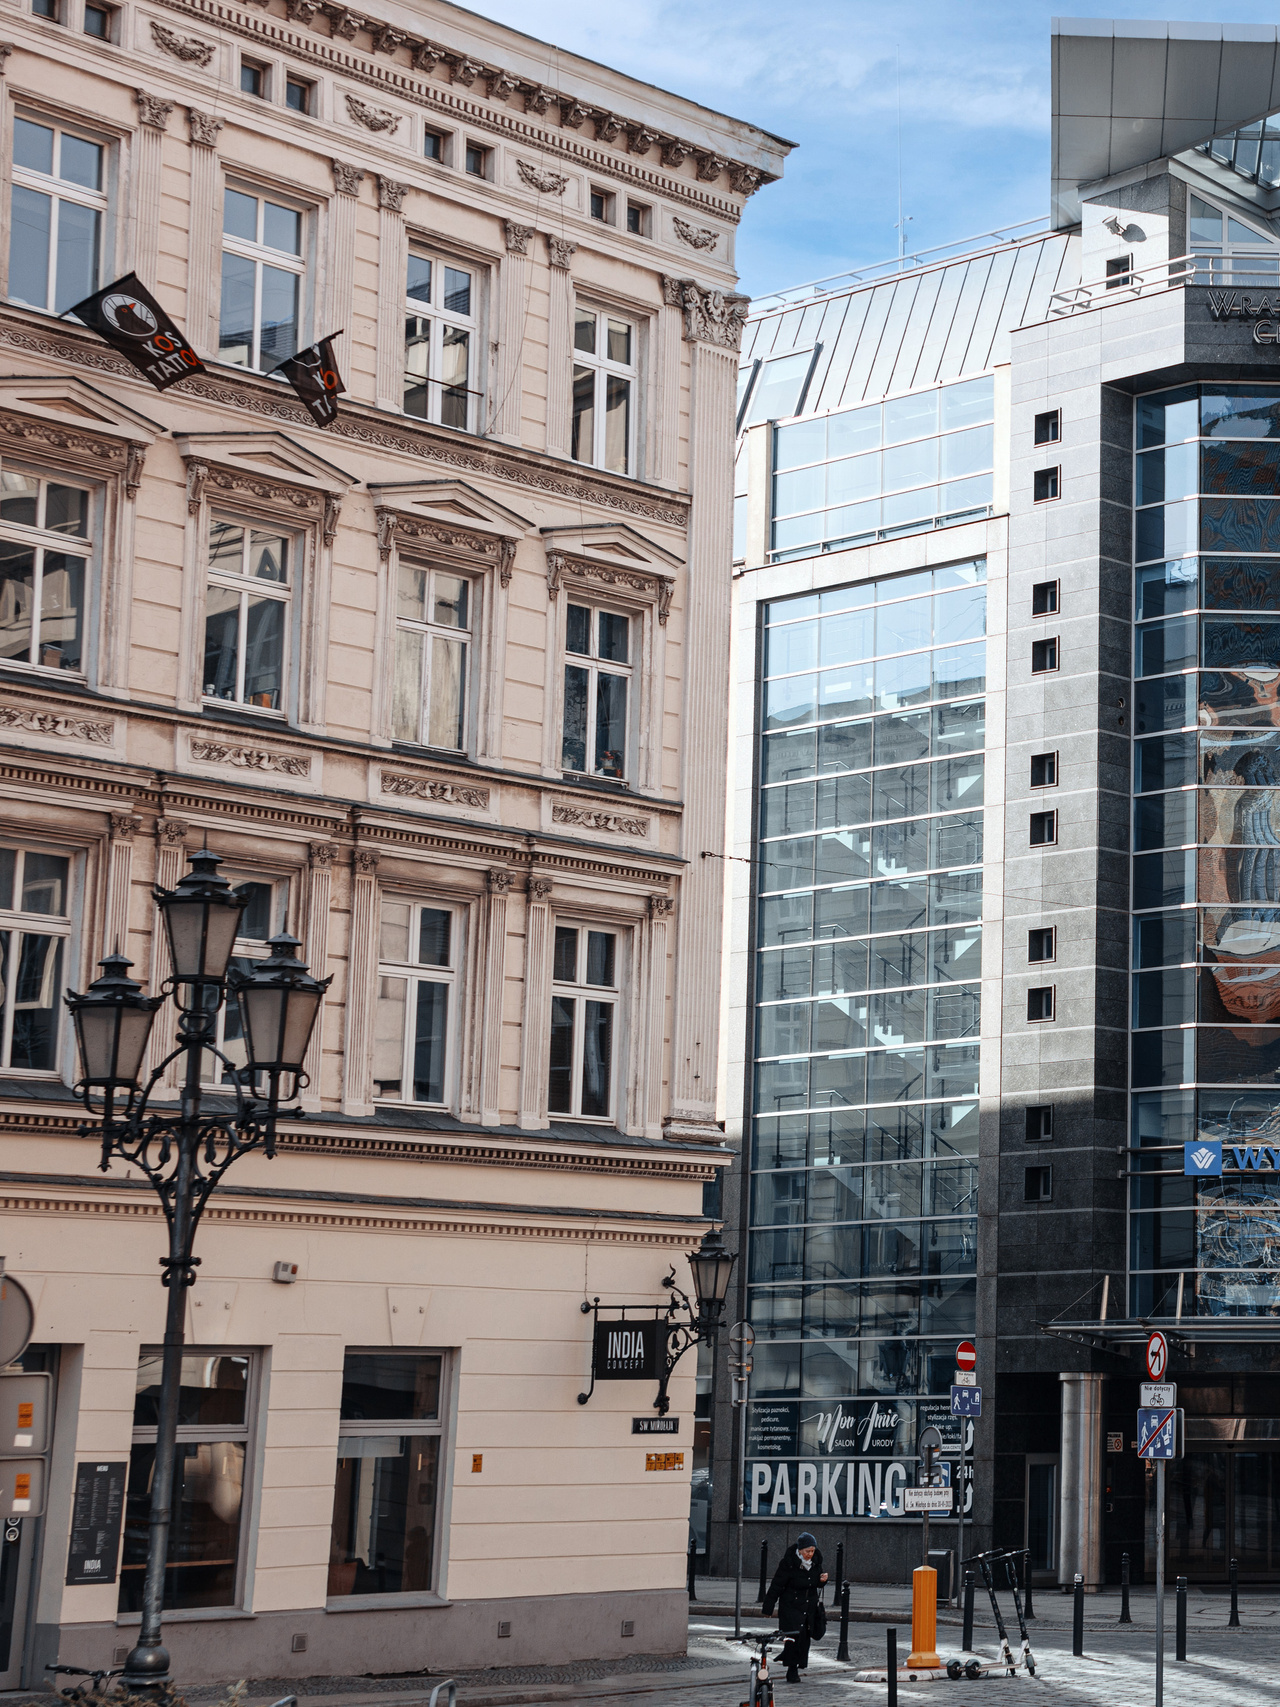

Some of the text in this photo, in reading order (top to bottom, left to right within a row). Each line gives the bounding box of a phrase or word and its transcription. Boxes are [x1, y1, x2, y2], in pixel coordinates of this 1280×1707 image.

[142, 331, 183, 358] KOS
[607, 1331, 645, 1359] INDIA
[606, 1359, 645, 1370] CONCEPT
[800, 1401, 917, 1453] Mon Amie
[834, 1439, 895, 1447] SALON URODY
[750, 1462, 907, 1517] PARKING
